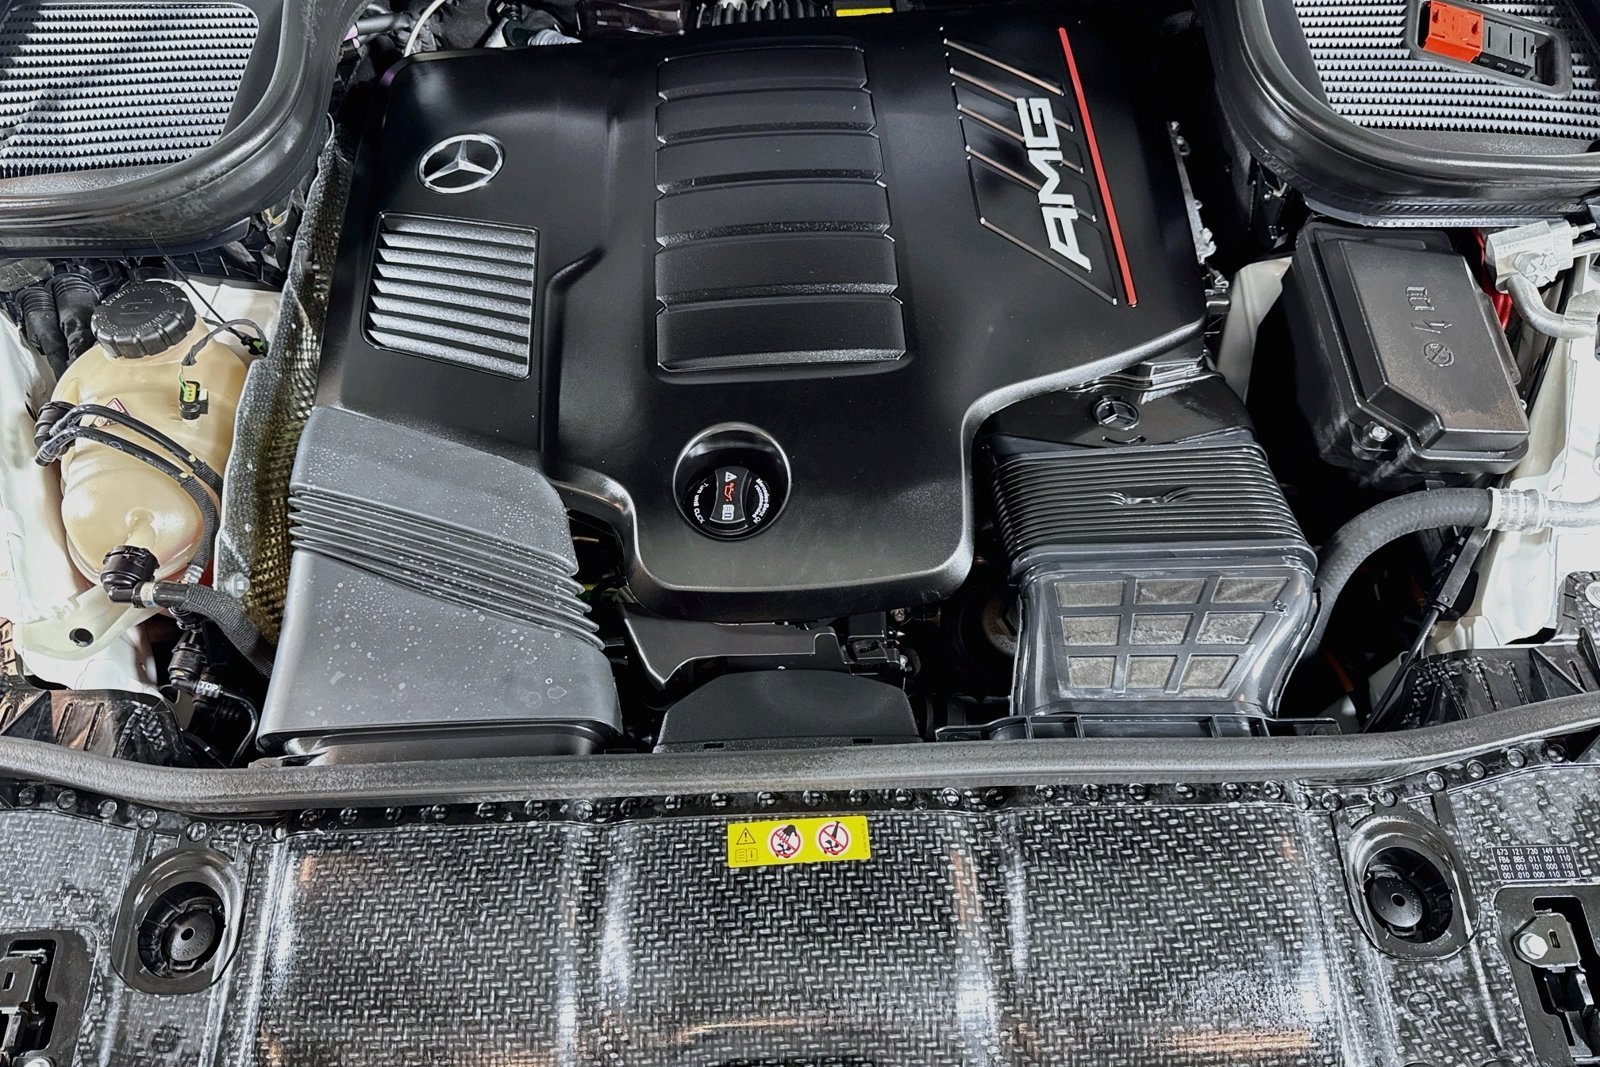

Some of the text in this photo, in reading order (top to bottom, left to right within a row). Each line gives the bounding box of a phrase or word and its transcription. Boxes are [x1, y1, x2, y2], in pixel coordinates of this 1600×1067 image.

[1016, 97, 1092, 271] AMG
[697, 482, 709, 493] Turn
[693, 508, 705, 523] CLICK
